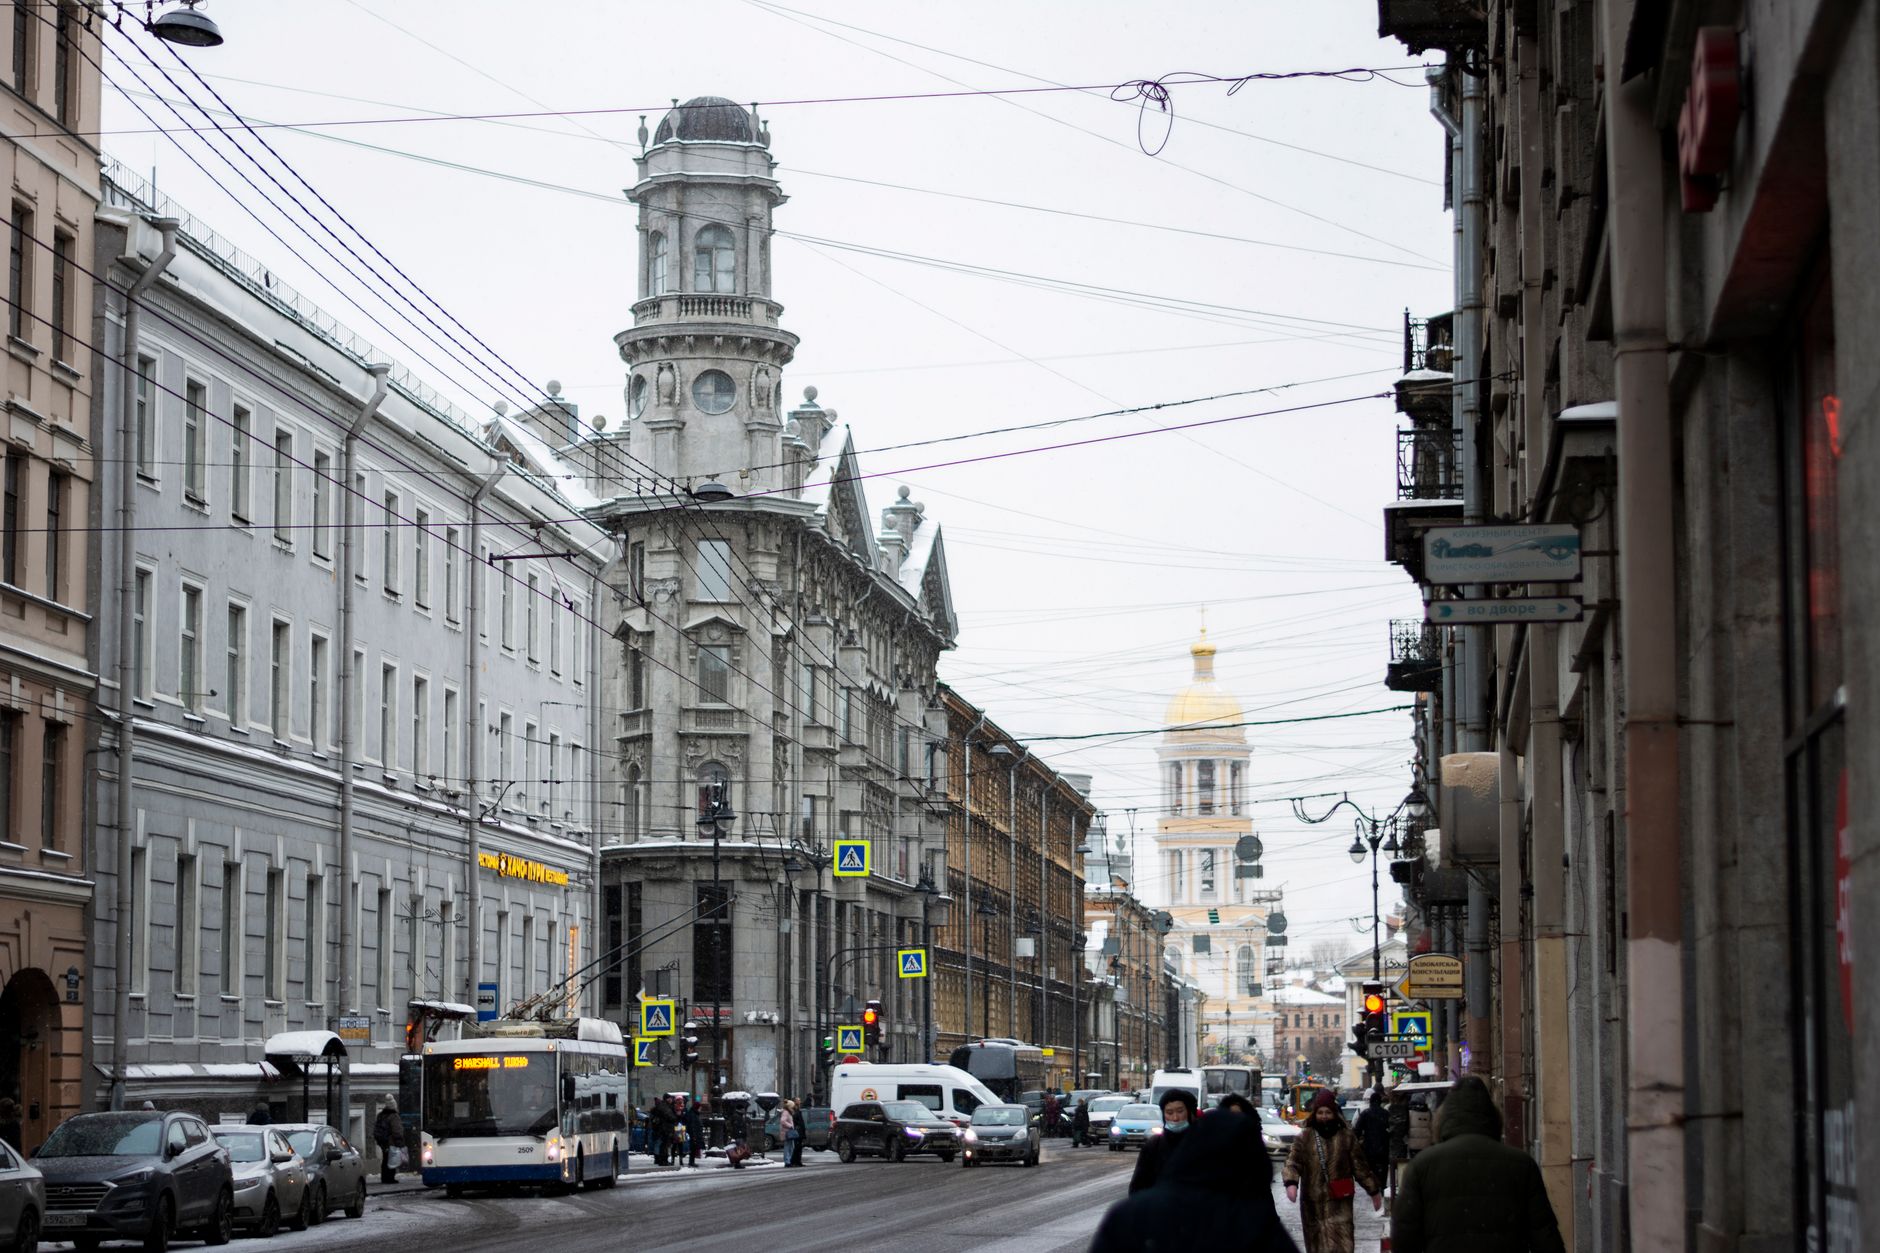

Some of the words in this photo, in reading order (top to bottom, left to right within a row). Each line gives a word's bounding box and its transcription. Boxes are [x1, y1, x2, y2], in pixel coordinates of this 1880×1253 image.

[1452, 529, 1511, 538] КРУИЗНЫЙ
[1513, 528, 1549, 538] ЦЕНТР
[1467, 606, 1484, 615] во
[1489, 603, 1536, 617] дворе
[507, 855, 524, 879] ХАЧО
[528, 860, 545, 883] ПУРИ
[1374, 1044, 1408, 1056] СТОП
[454, 1058, 462, 1069] 3
[462, 1057, 500, 1069] MARSHALL
[518, 1146, 534, 1154] 2509
